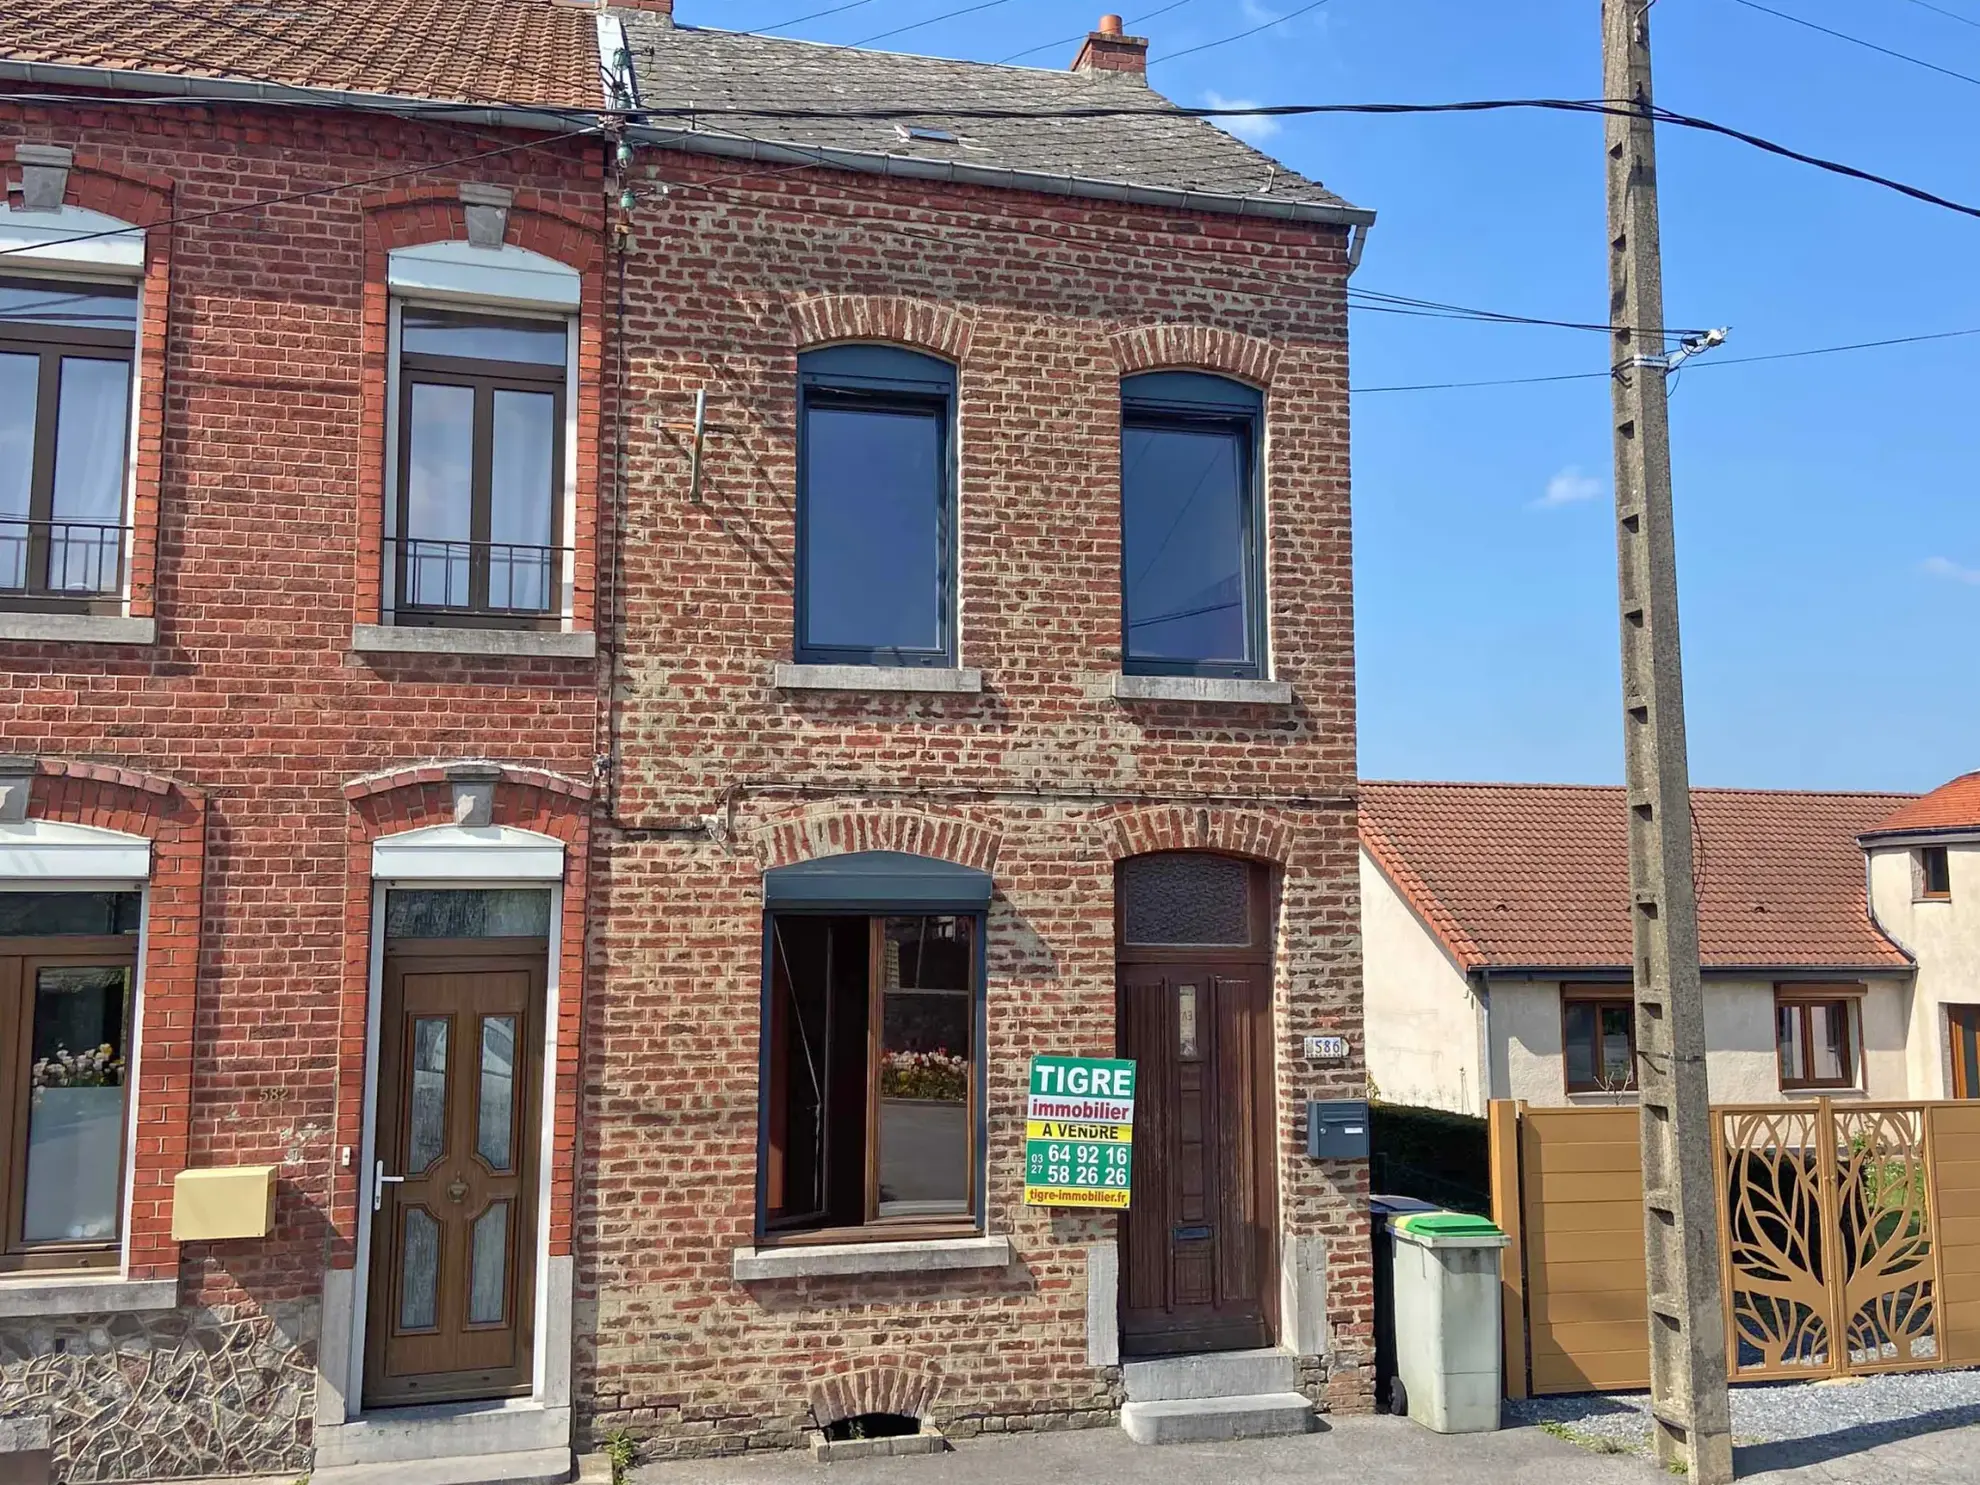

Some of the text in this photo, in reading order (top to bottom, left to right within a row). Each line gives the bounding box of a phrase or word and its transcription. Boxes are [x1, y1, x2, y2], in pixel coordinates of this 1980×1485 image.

[1314, 1039, 1341, 1054] 586
[1035, 1065, 1132, 1096] TIGRE
[259, 1087, 289, 1102] 582
[1032, 1098, 1130, 1120] immobilier
[1042, 1122, 1119, 1139] A VENDRE
[1031, 1153, 1044, 1163] 03
[1048, 1144, 1127, 1165] 64 92 16
[1030, 1164, 1043, 1174] 27
[1047, 1165, 1127, 1186] 58 26 26
[1029, 1188, 1127, 1203] tigre-immobilier.fr
